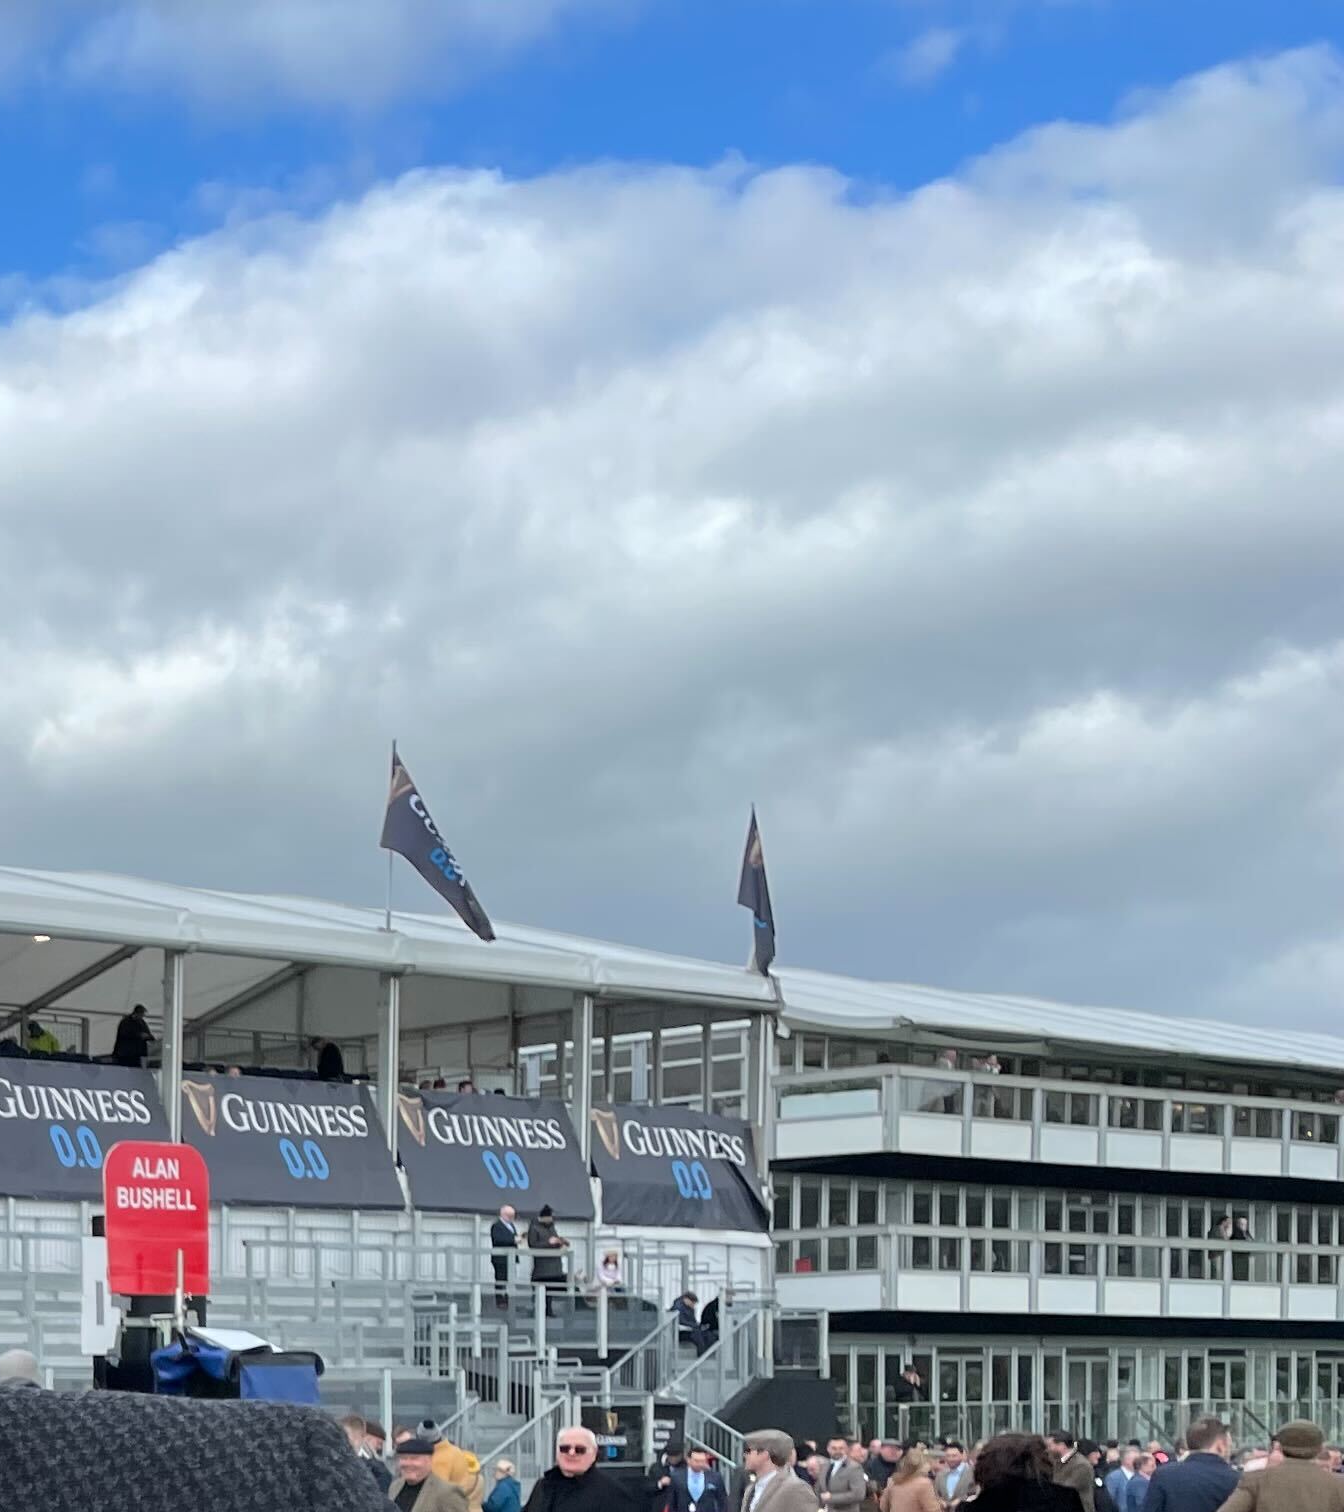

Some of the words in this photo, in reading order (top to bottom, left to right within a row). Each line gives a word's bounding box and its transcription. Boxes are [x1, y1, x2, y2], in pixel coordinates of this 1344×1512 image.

[221, 1093, 369, 1138] GUINNESS
[427, 1107, 567, 1150] GUINNESS
[49, 1124, 103, 1169] 0.0
[278, 1137, 330, 1181] 0.0
[622, 1120, 746, 1167] GUINNESS
[132, 1157, 180, 1180] ALAN
[481, 1150, 530, 1190] 0.0
[672, 1160, 712, 1200] 0.0
[116, 1186, 197, 1211] BUSHELL
